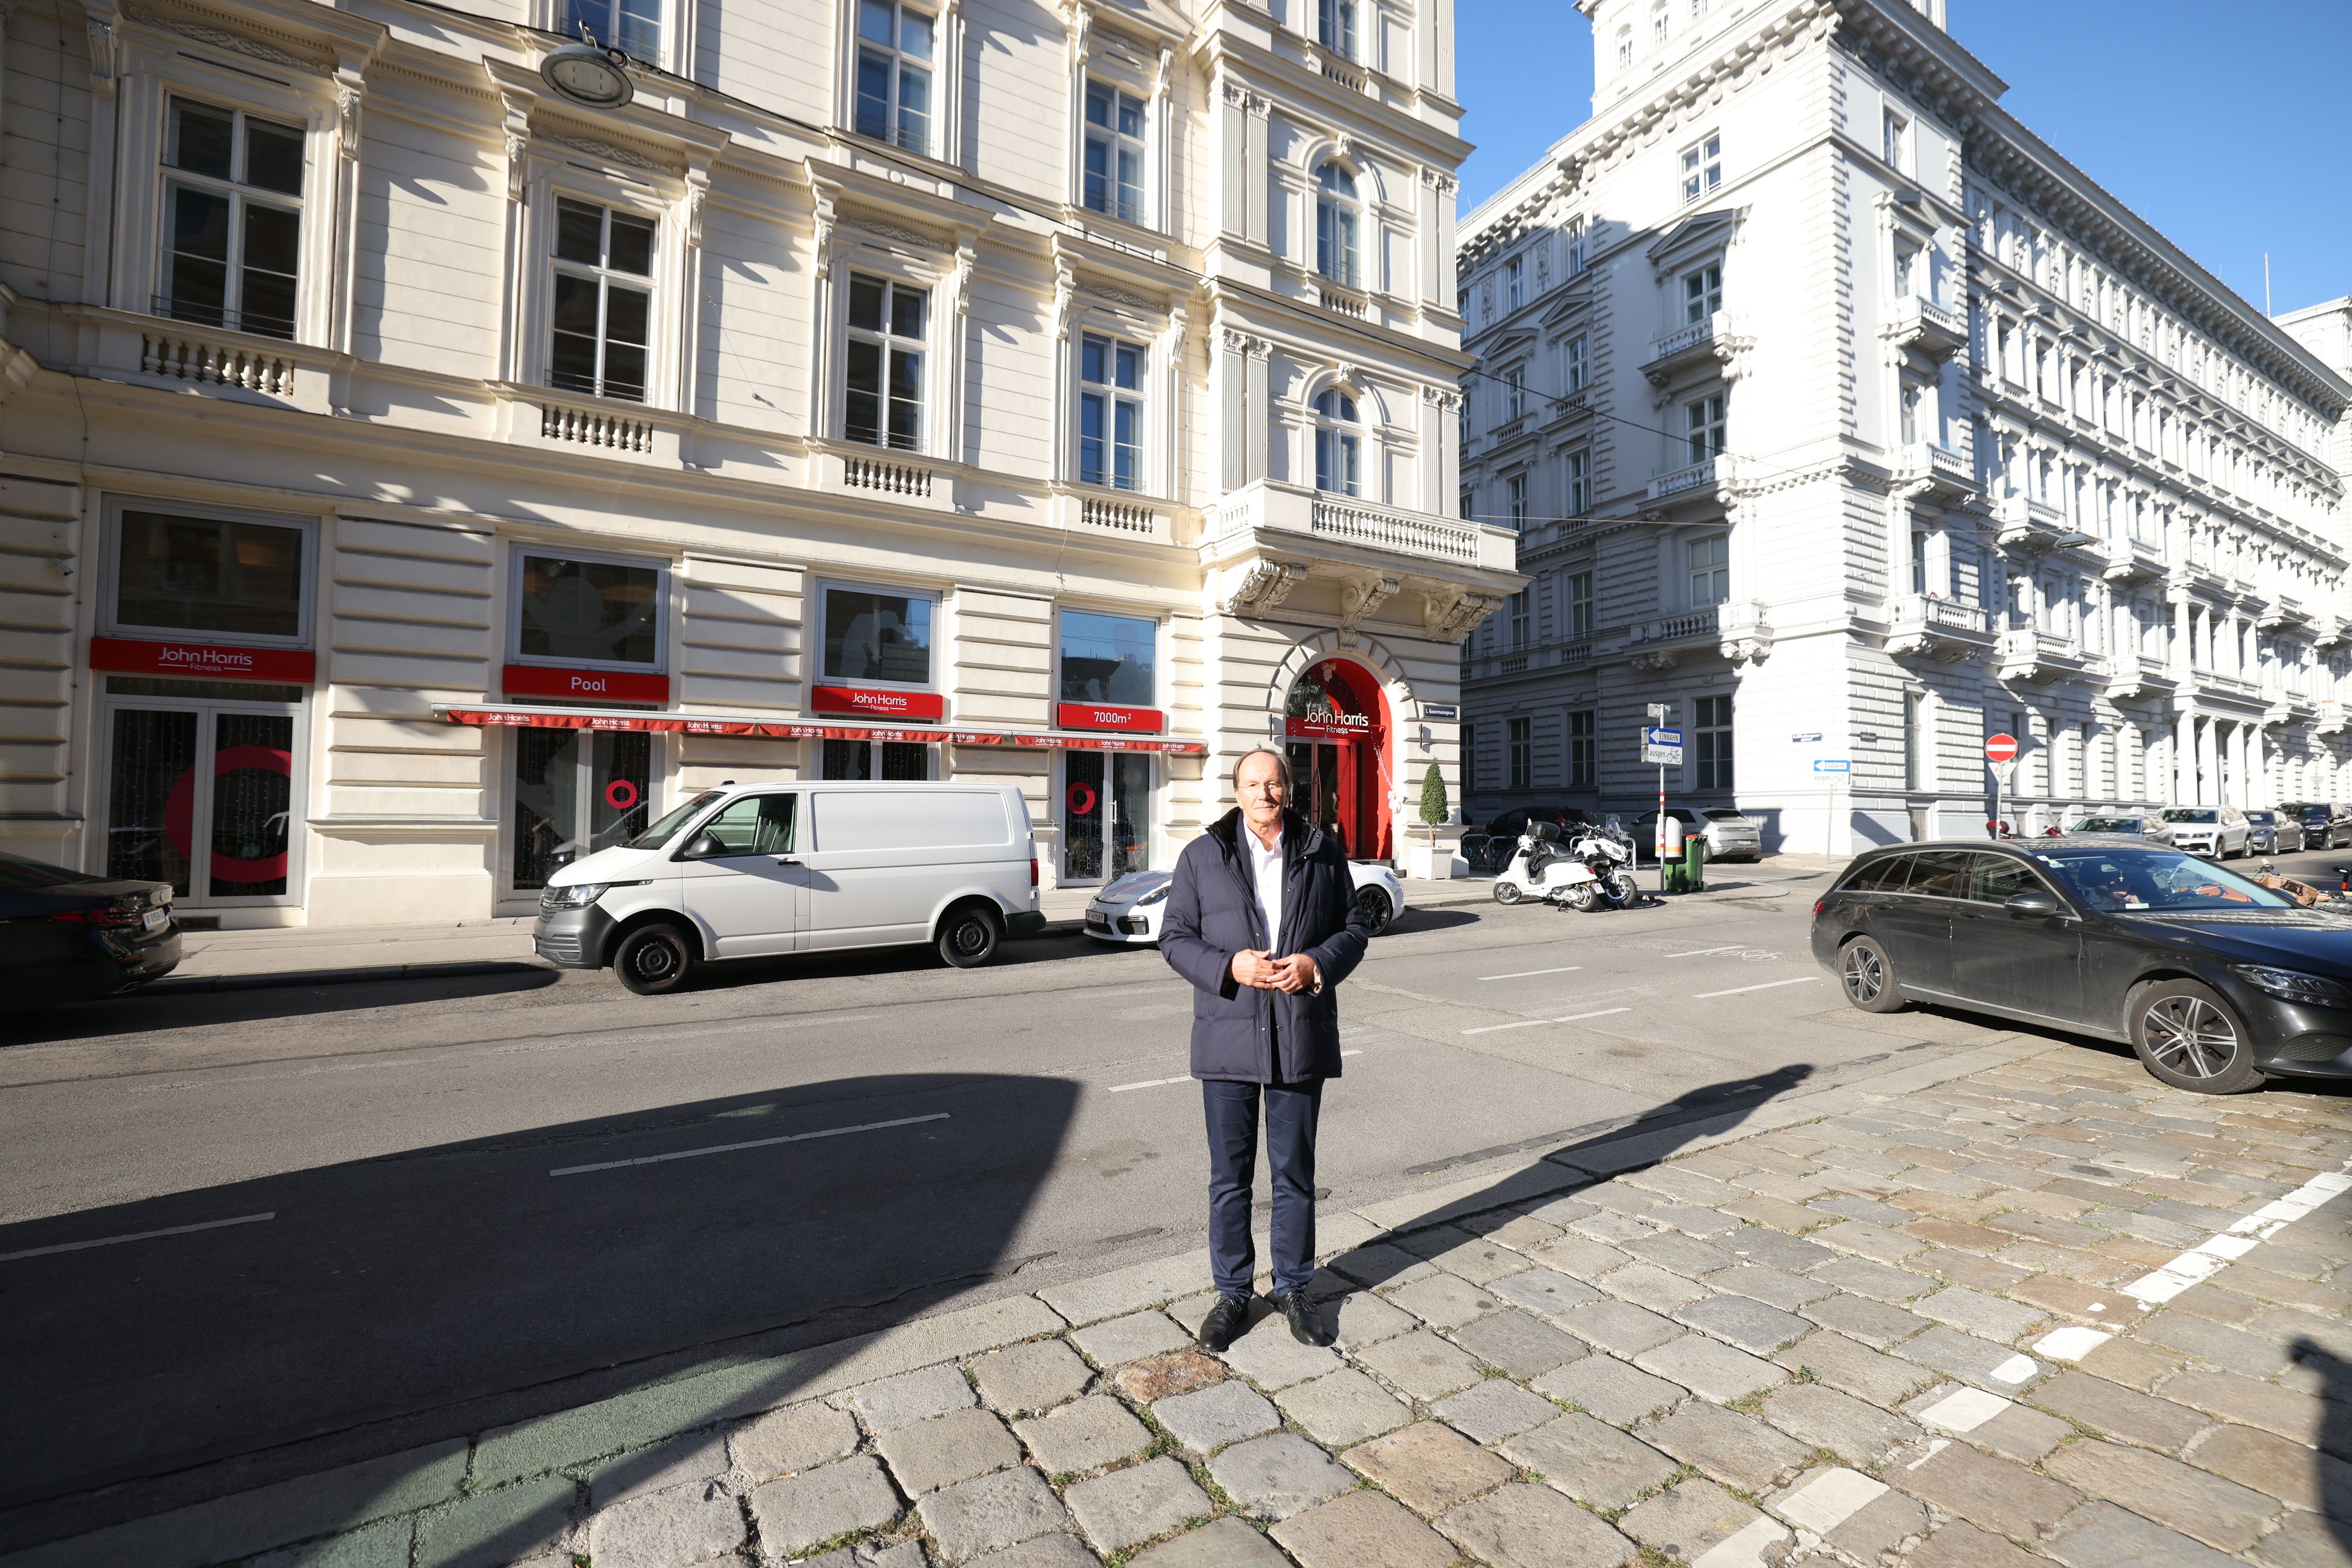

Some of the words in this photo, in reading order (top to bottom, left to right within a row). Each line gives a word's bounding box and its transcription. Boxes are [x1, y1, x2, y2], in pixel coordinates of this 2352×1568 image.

[158, 647, 201, 662] John
[203, 650, 253, 666] Harris
[189, 663, 222, 671] Fitness
[571, 677, 606, 691] Pool
[852, 693, 877, 704] John
[878, 694, 907, 706] Harris
[1304, 707, 1333, 724] John
[1334, 710, 1369, 727] Harris
[1659, 733, 1679, 742] EINBAHN
[1649, 750, 1667, 758] ausgen.
